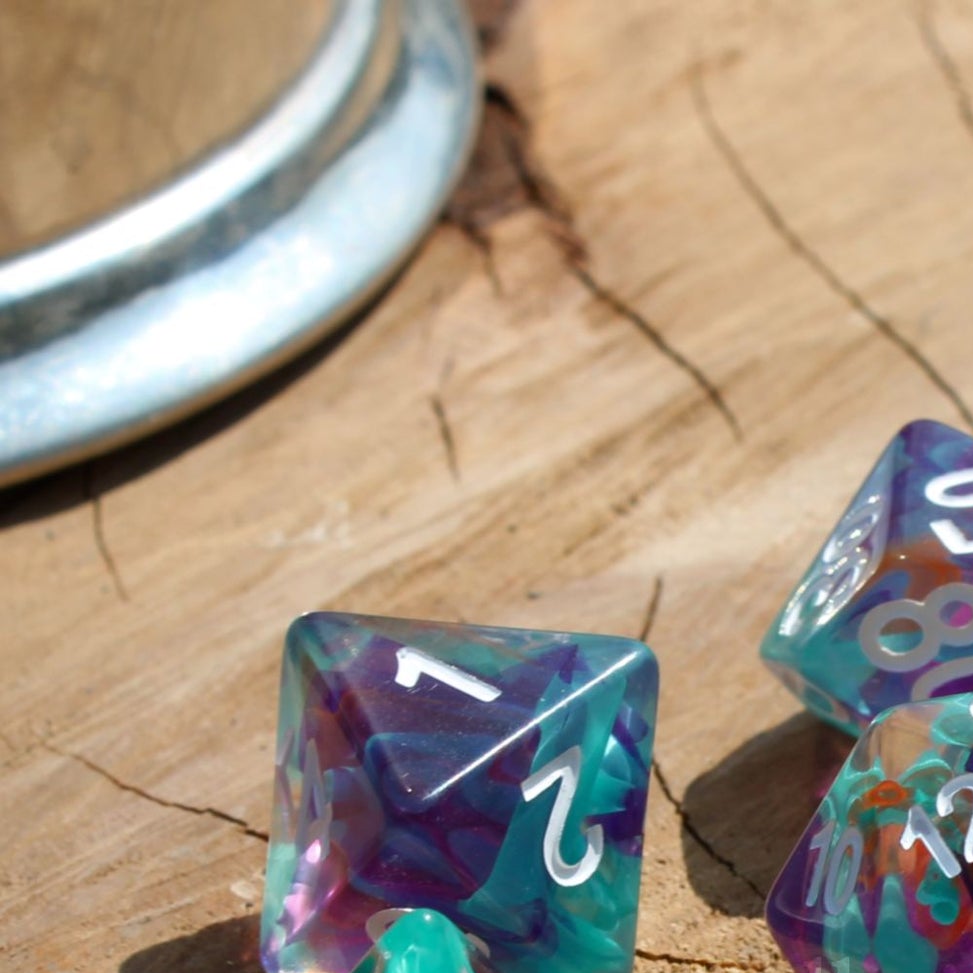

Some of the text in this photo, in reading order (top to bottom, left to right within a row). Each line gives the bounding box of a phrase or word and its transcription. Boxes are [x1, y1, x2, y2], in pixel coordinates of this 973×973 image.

[396, 646, 502, 702] 1
[521, 745, 604, 887] 2
[806, 821, 863, 916] 10
